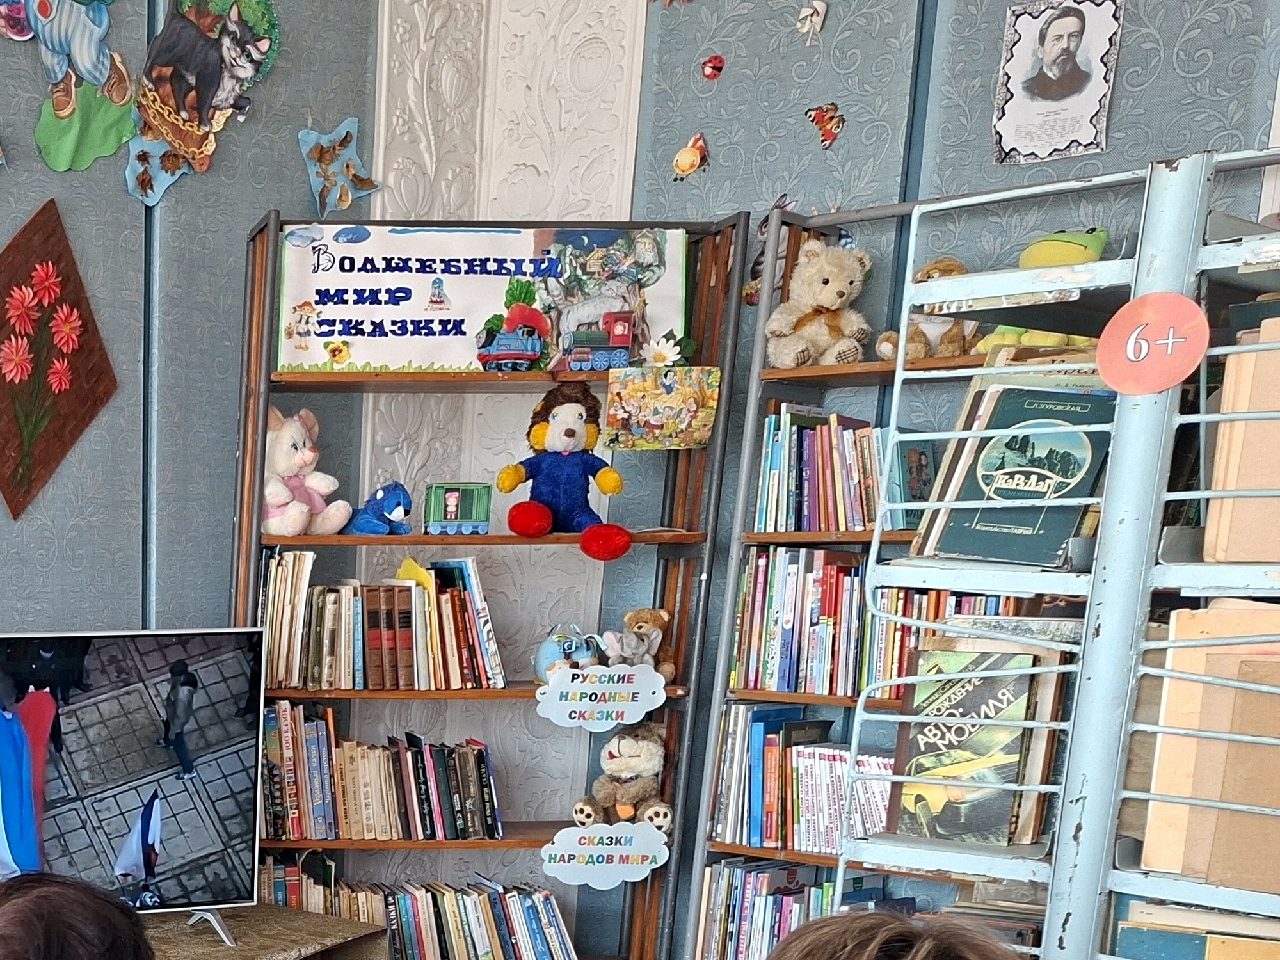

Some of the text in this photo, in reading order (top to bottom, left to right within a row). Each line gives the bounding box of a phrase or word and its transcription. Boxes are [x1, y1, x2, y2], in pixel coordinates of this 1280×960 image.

[314, 286, 413, 307] МИР
[313, 312, 468, 339] СКАЗКИ
[1124, 323, 1188, 364] 6+
[570, 673, 636, 685] РУССКИЕ
[558, 691, 640, 704] НАРОДНЫЕ
[568, 709, 625, 721] СКАЗКИ
[577, 836, 634, 847] СКАЗКИ
[547, 854, 659, 865] НАРОДОВ МИРА
